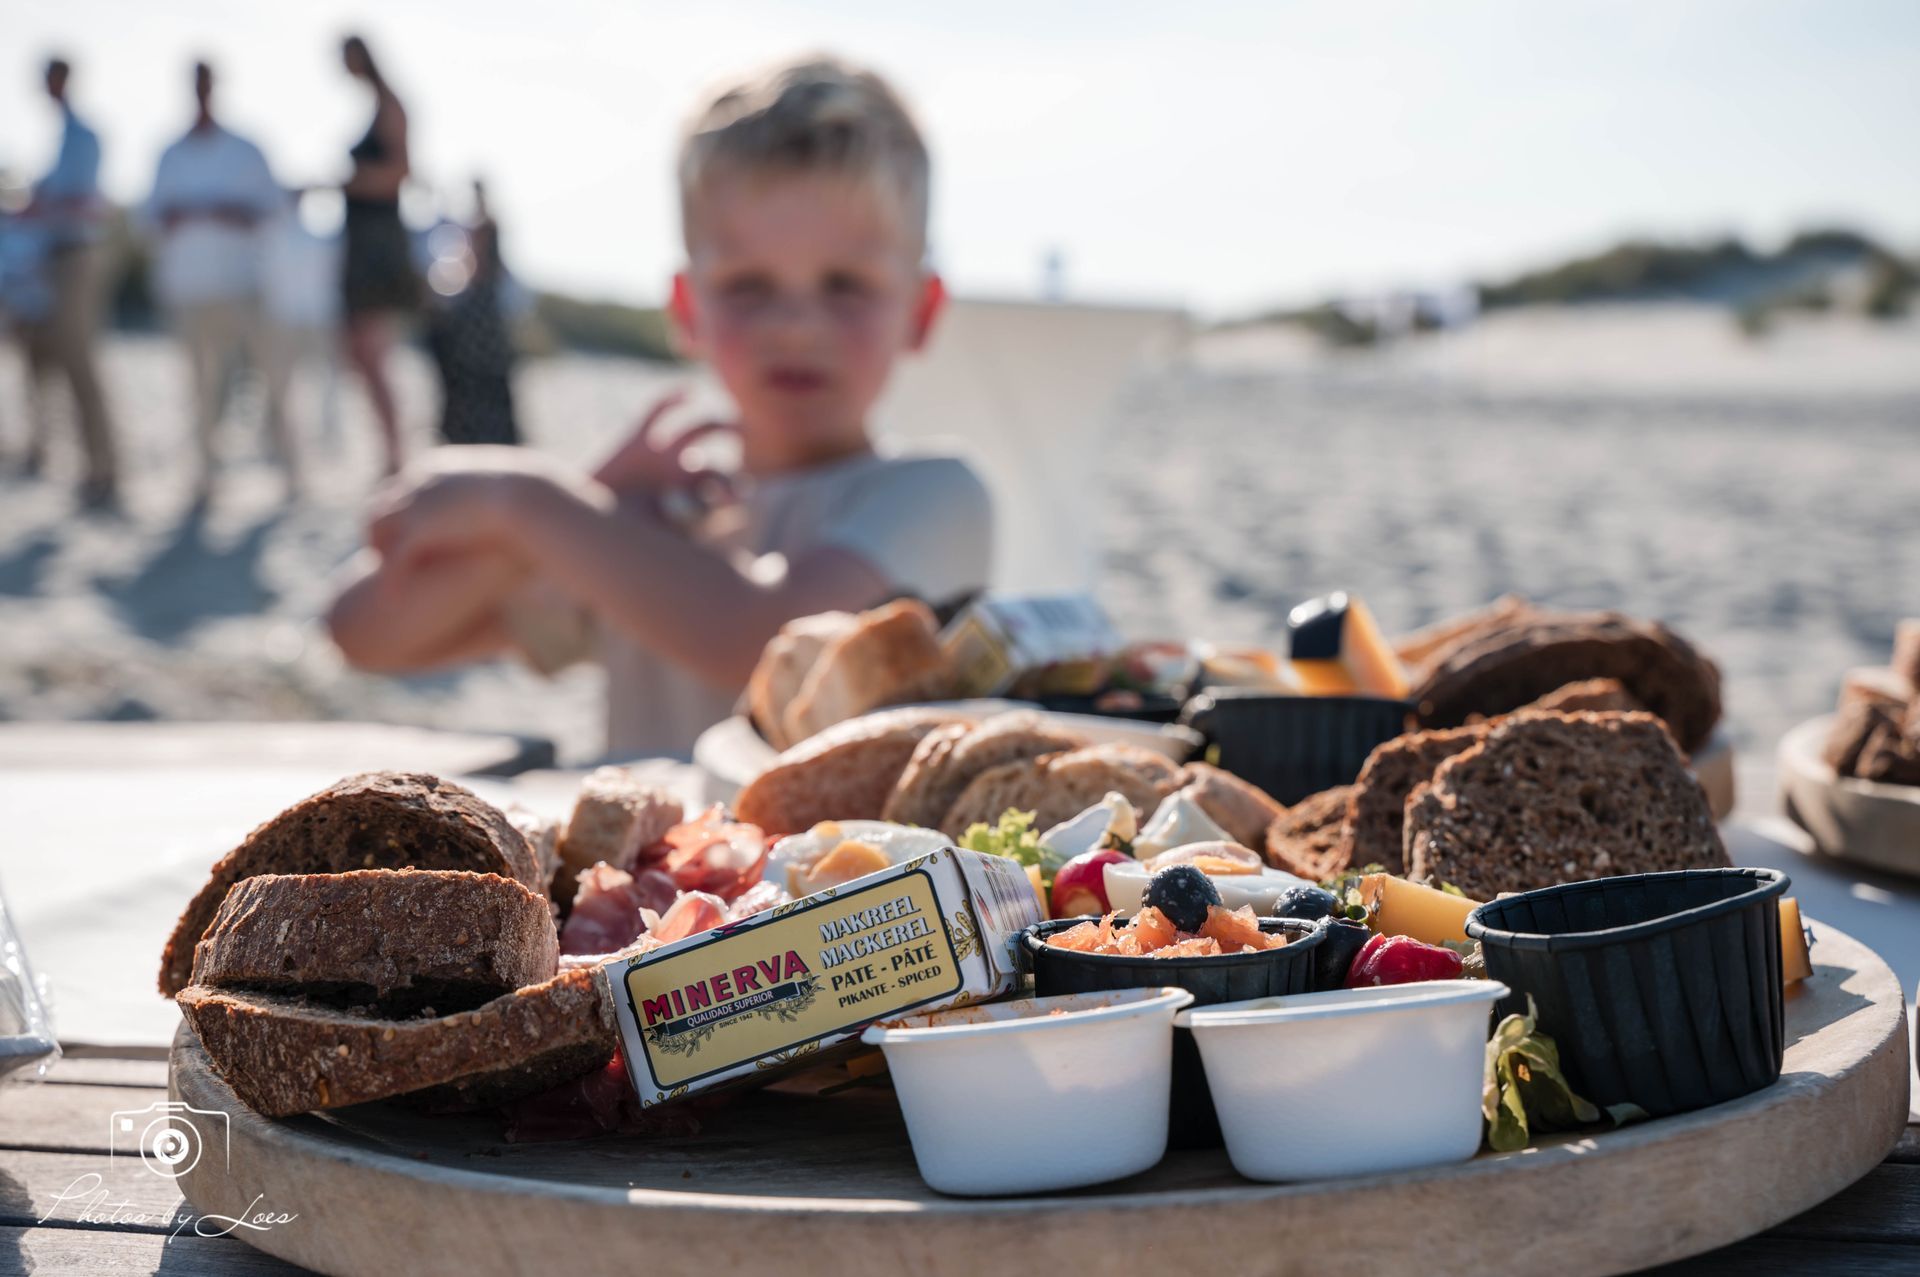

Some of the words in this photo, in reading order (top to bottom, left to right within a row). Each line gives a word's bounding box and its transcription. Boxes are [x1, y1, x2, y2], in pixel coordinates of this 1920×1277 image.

[818, 895, 922, 943] MAKREEL
[818, 917, 936, 970] MACKEREL
[831, 963, 877, 992] PATE
[890, 940, 938, 971] PÂTÉ
[642, 950, 811, 1026] MINERVA
[687, 1005, 733, 1027] QUALIDADE
[734, 991, 774, 1011] SUPERIOR
[838, 982, 889, 1008] PIKANTE
[897, 965, 941, 988] SPICED
[718, 1017, 738, 1028] SINCE
